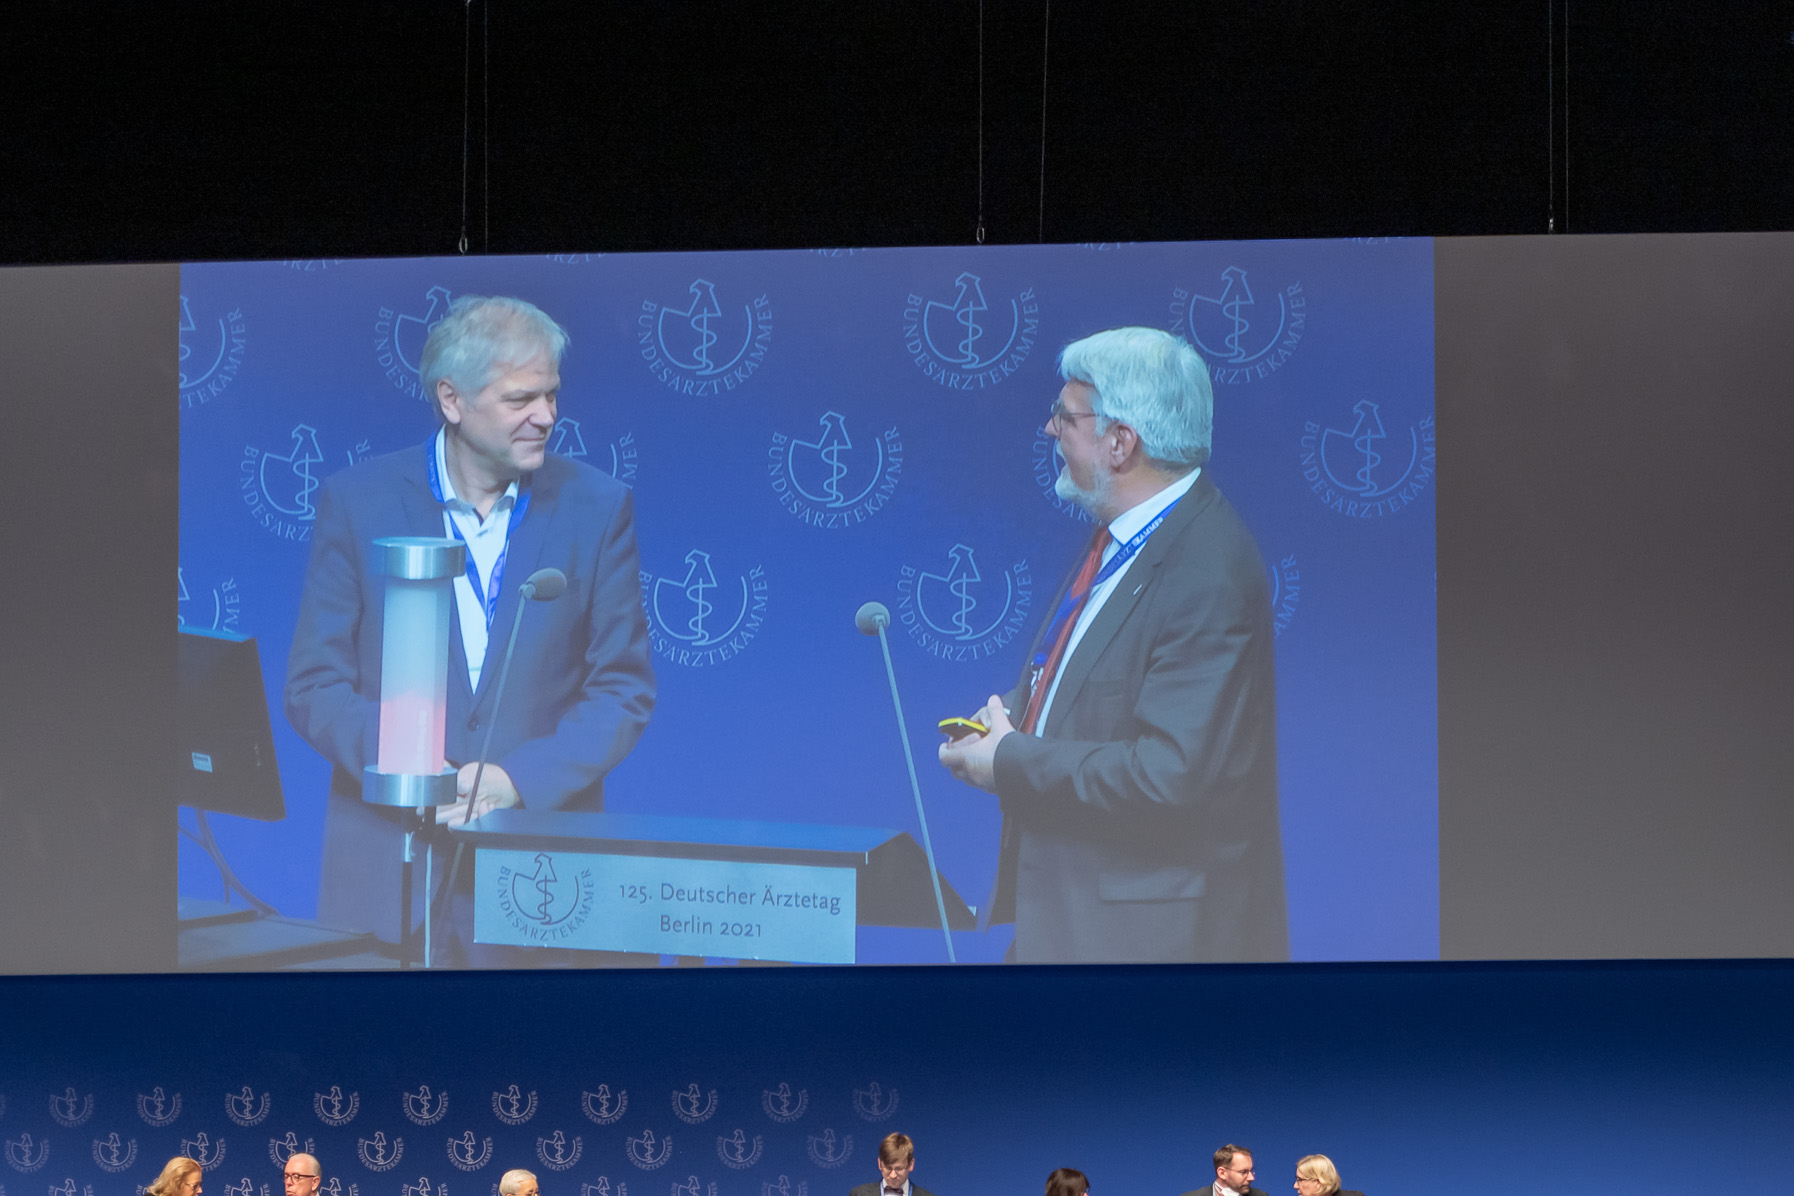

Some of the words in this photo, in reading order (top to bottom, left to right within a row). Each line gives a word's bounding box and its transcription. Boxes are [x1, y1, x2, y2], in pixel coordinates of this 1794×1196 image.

[638, 293, 772, 397] BUNDESÄRZTEKAMMER
[903, 287, 1038, 390] BUNDESÄRZTEKAMMER
[1169, 281, 1306, 384] BUNRZTEKAMMER
[768, 426, 903, 528] BUNDESÄRZTEKAMMER
[897, 559, 1032, 662] BUNDESÄRZTEKAMMER
[620, 885, 652, 905] 125.
[661, 883, 756, 904] Deutscher
[762, 885, 841, 915] Ärztetag
[660, 915, 713, 934] Berlin
[720, 921, 763, 937] 2021
